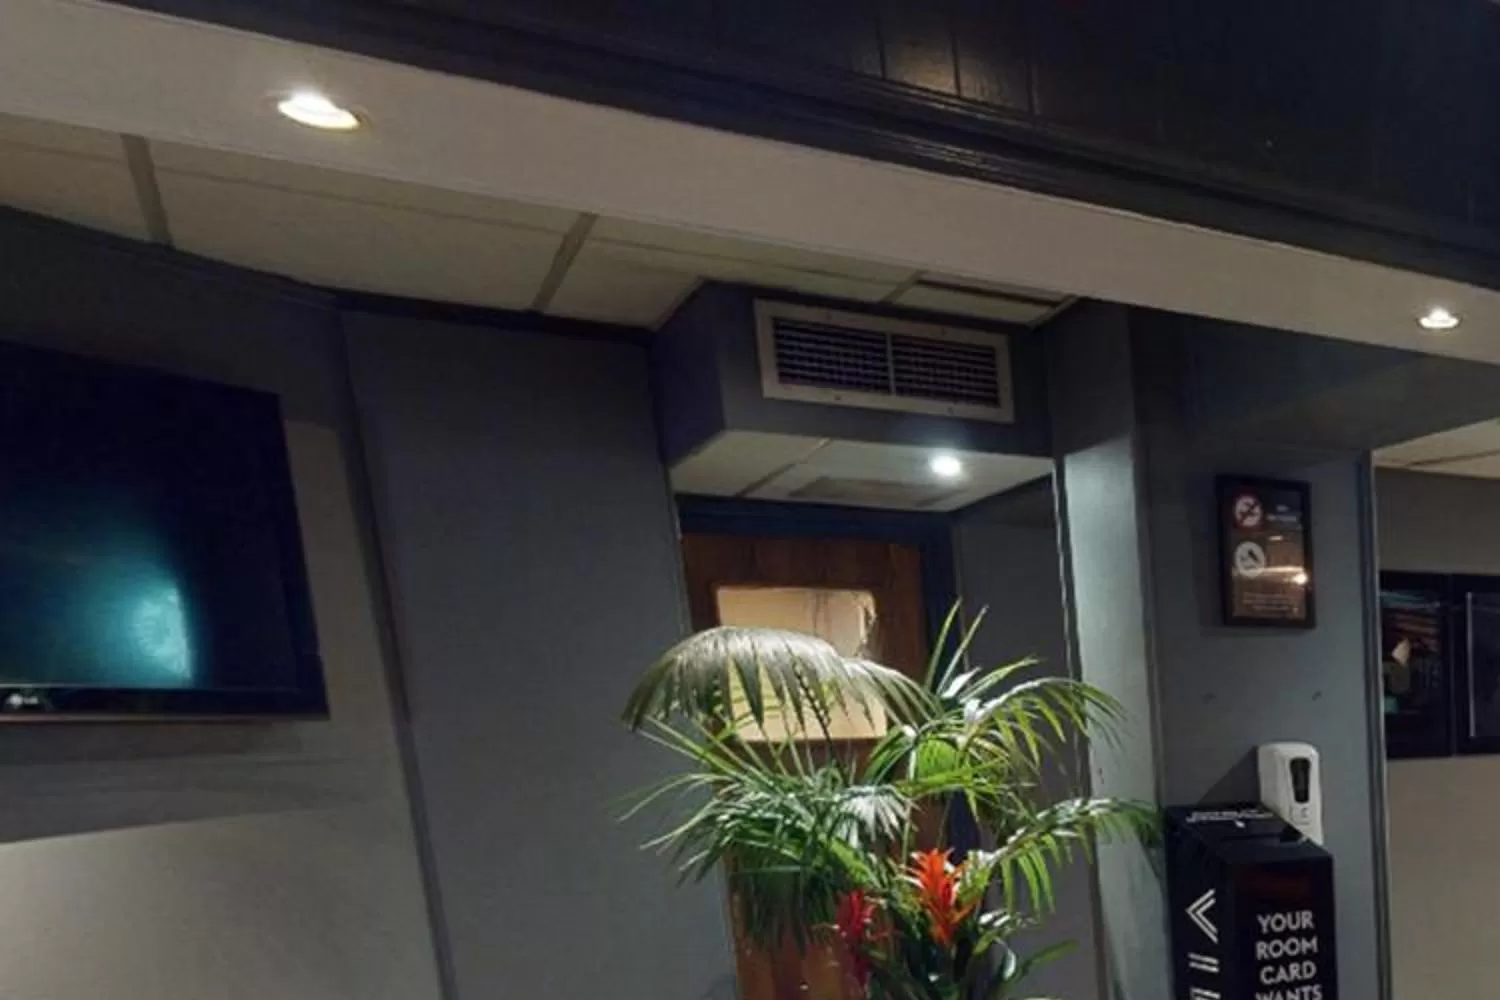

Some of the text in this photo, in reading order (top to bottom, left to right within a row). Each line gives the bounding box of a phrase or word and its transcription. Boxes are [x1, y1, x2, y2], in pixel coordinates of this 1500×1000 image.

[1257, 910, 1314, 934] YOUR
[1255, 936, 1318, 961] ROOM
[1260, 960, 1317, 985] CARD
